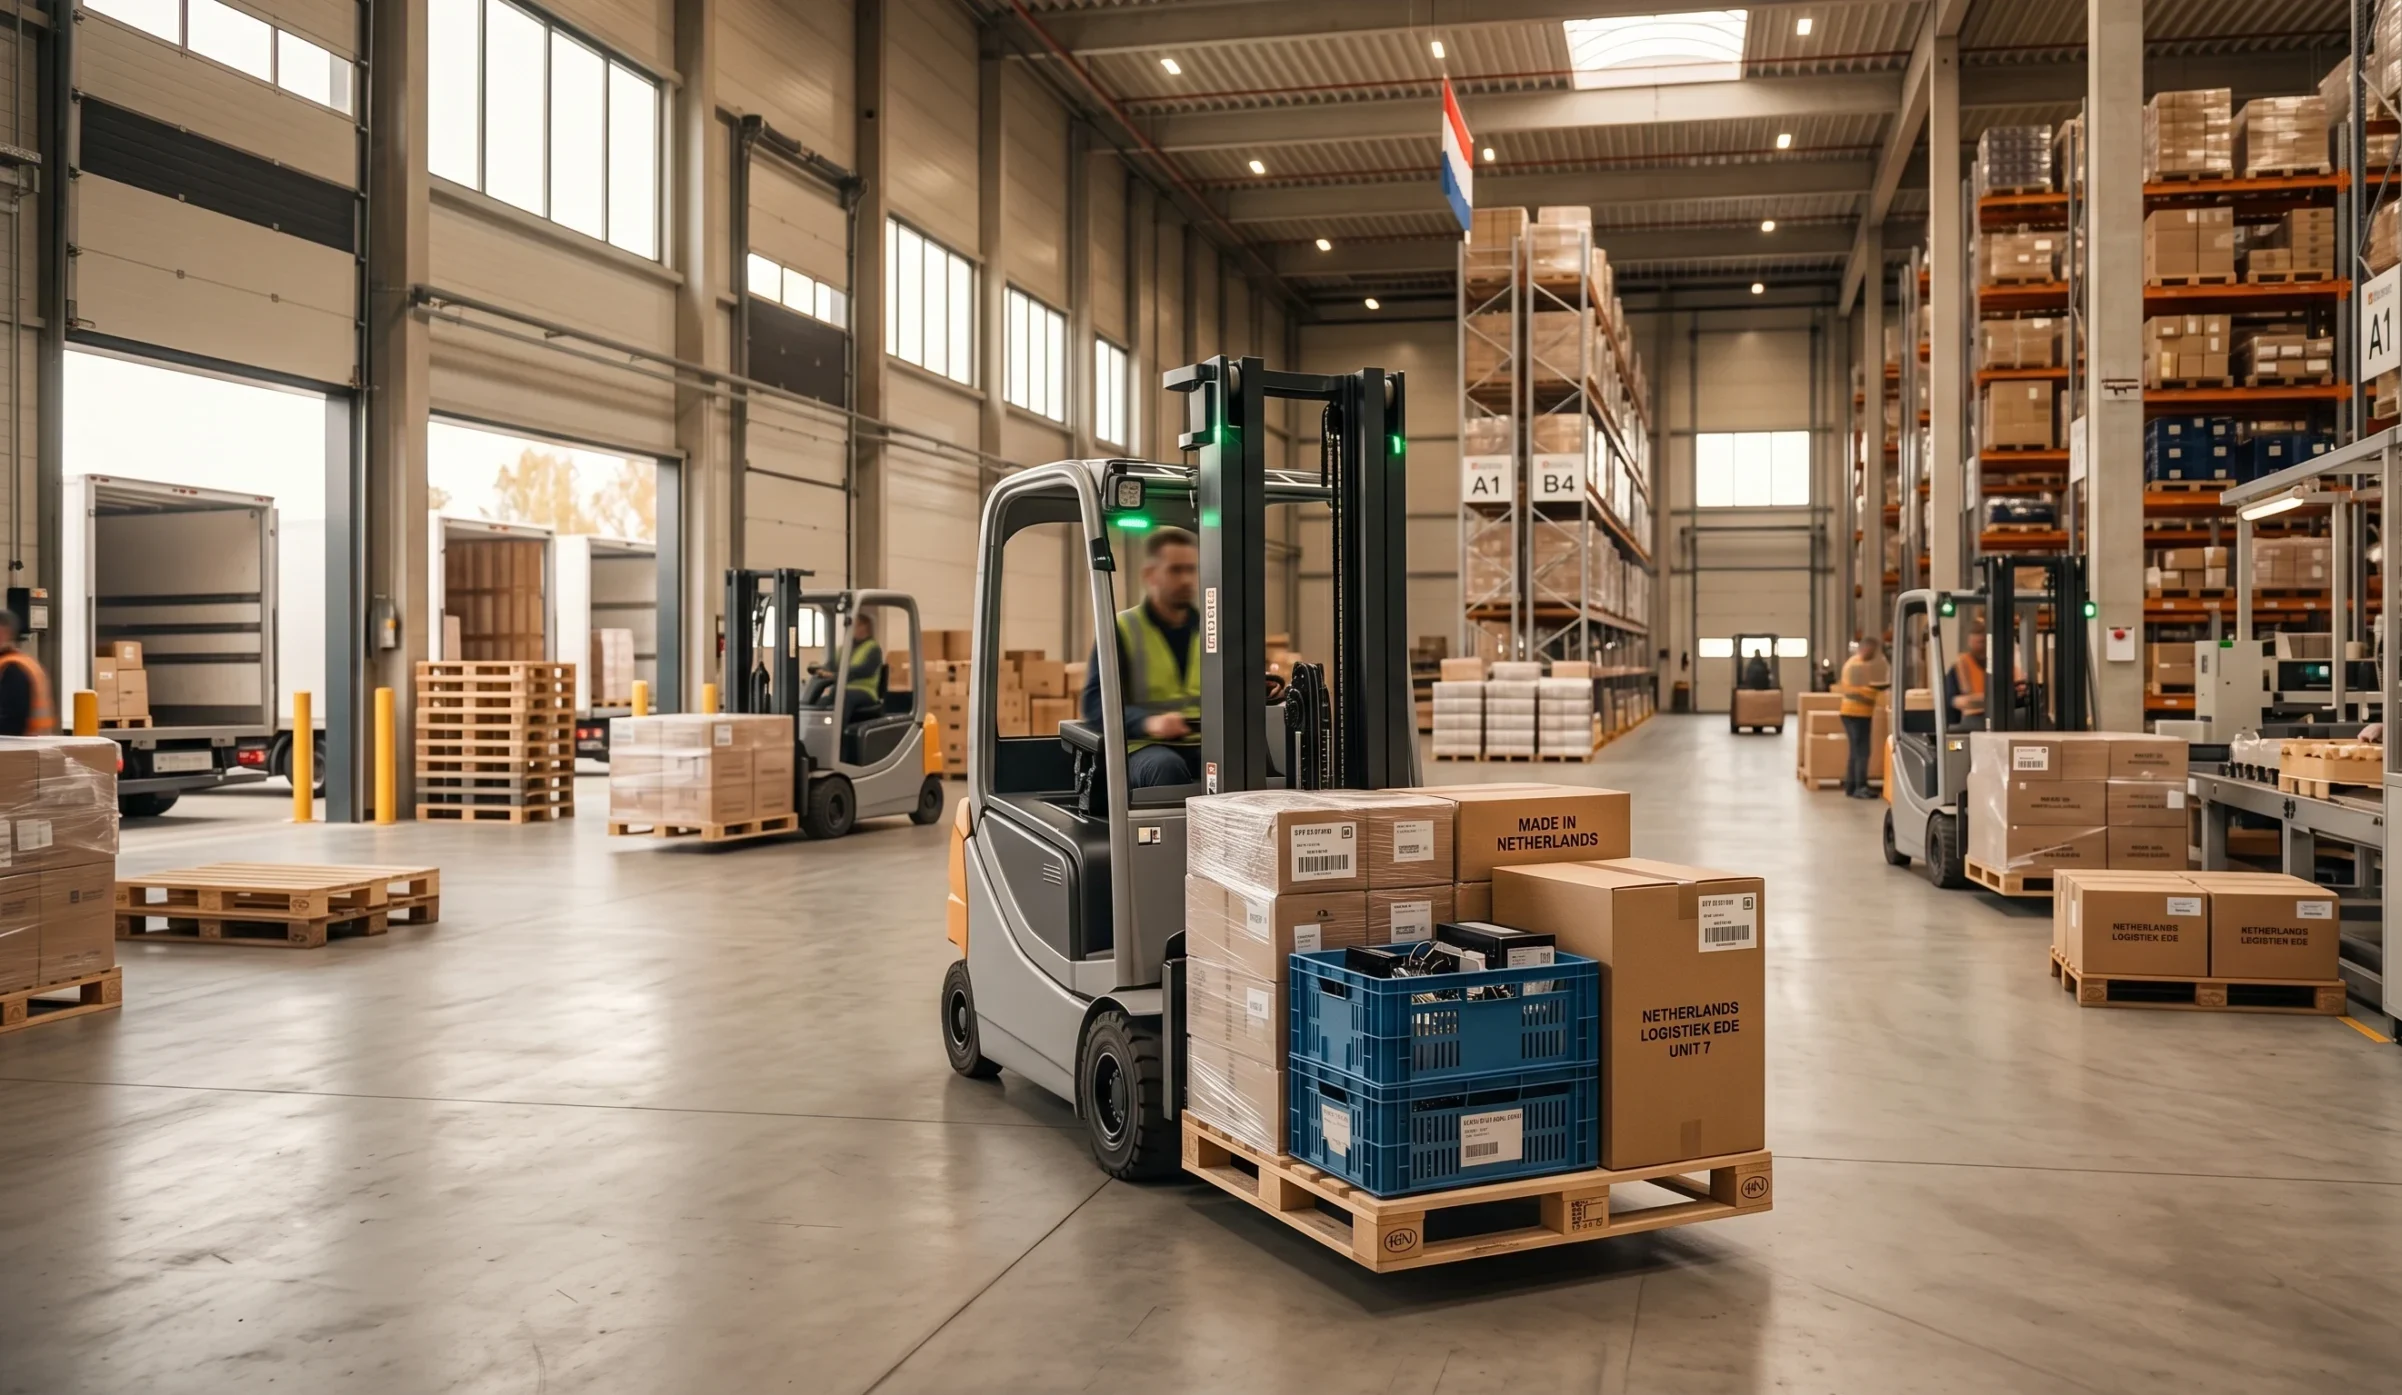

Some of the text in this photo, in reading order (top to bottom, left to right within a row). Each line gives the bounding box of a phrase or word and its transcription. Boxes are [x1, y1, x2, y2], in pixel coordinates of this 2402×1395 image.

[2369, 307, 2391, 360] A1
[1472, 475, 1500, 495] A1
[1543, 474, 1575, 493] B4
[1518, 815, 1576, 832] MADE IN
[1497, 832, 1599, 851] NETHERLANDS
[2161, 934, 2179, 942] EDE
[1642, 1001, 1740, 1023] NETHERLANDS
[1640, 1019, 1740, 1042] LOGISTIEK EDE
[1669, 1041, 1711, 1058] UNIT 7
